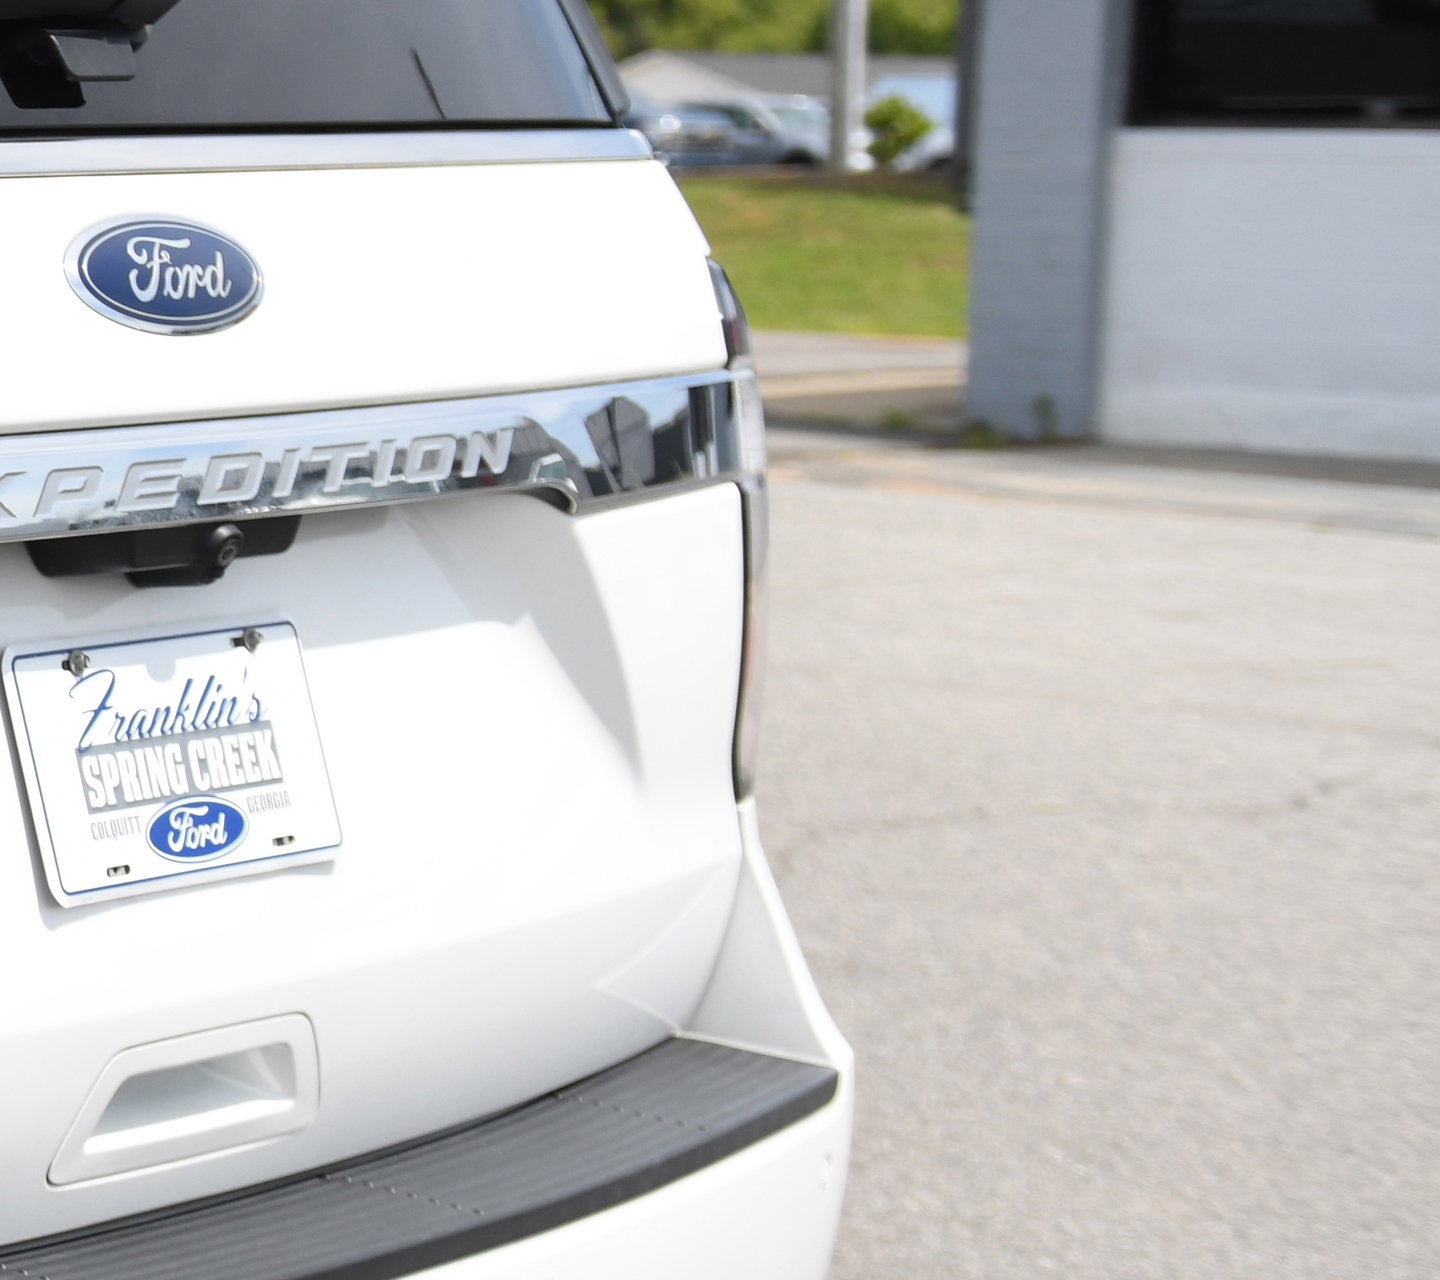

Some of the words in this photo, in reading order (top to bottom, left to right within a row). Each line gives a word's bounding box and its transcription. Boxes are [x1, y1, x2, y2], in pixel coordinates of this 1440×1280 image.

[126, 235, 232, 303] Ford
[68, 665, 267, 753] Franklin's
[80, 742, 190, 810] SPRING
[187, 728, 283, 793] CREEK
[89, 815, 143, 841] COLQUITT
[167, 805, 229, 853] Ford
[245, 790, 291, 815] GEORGIA
